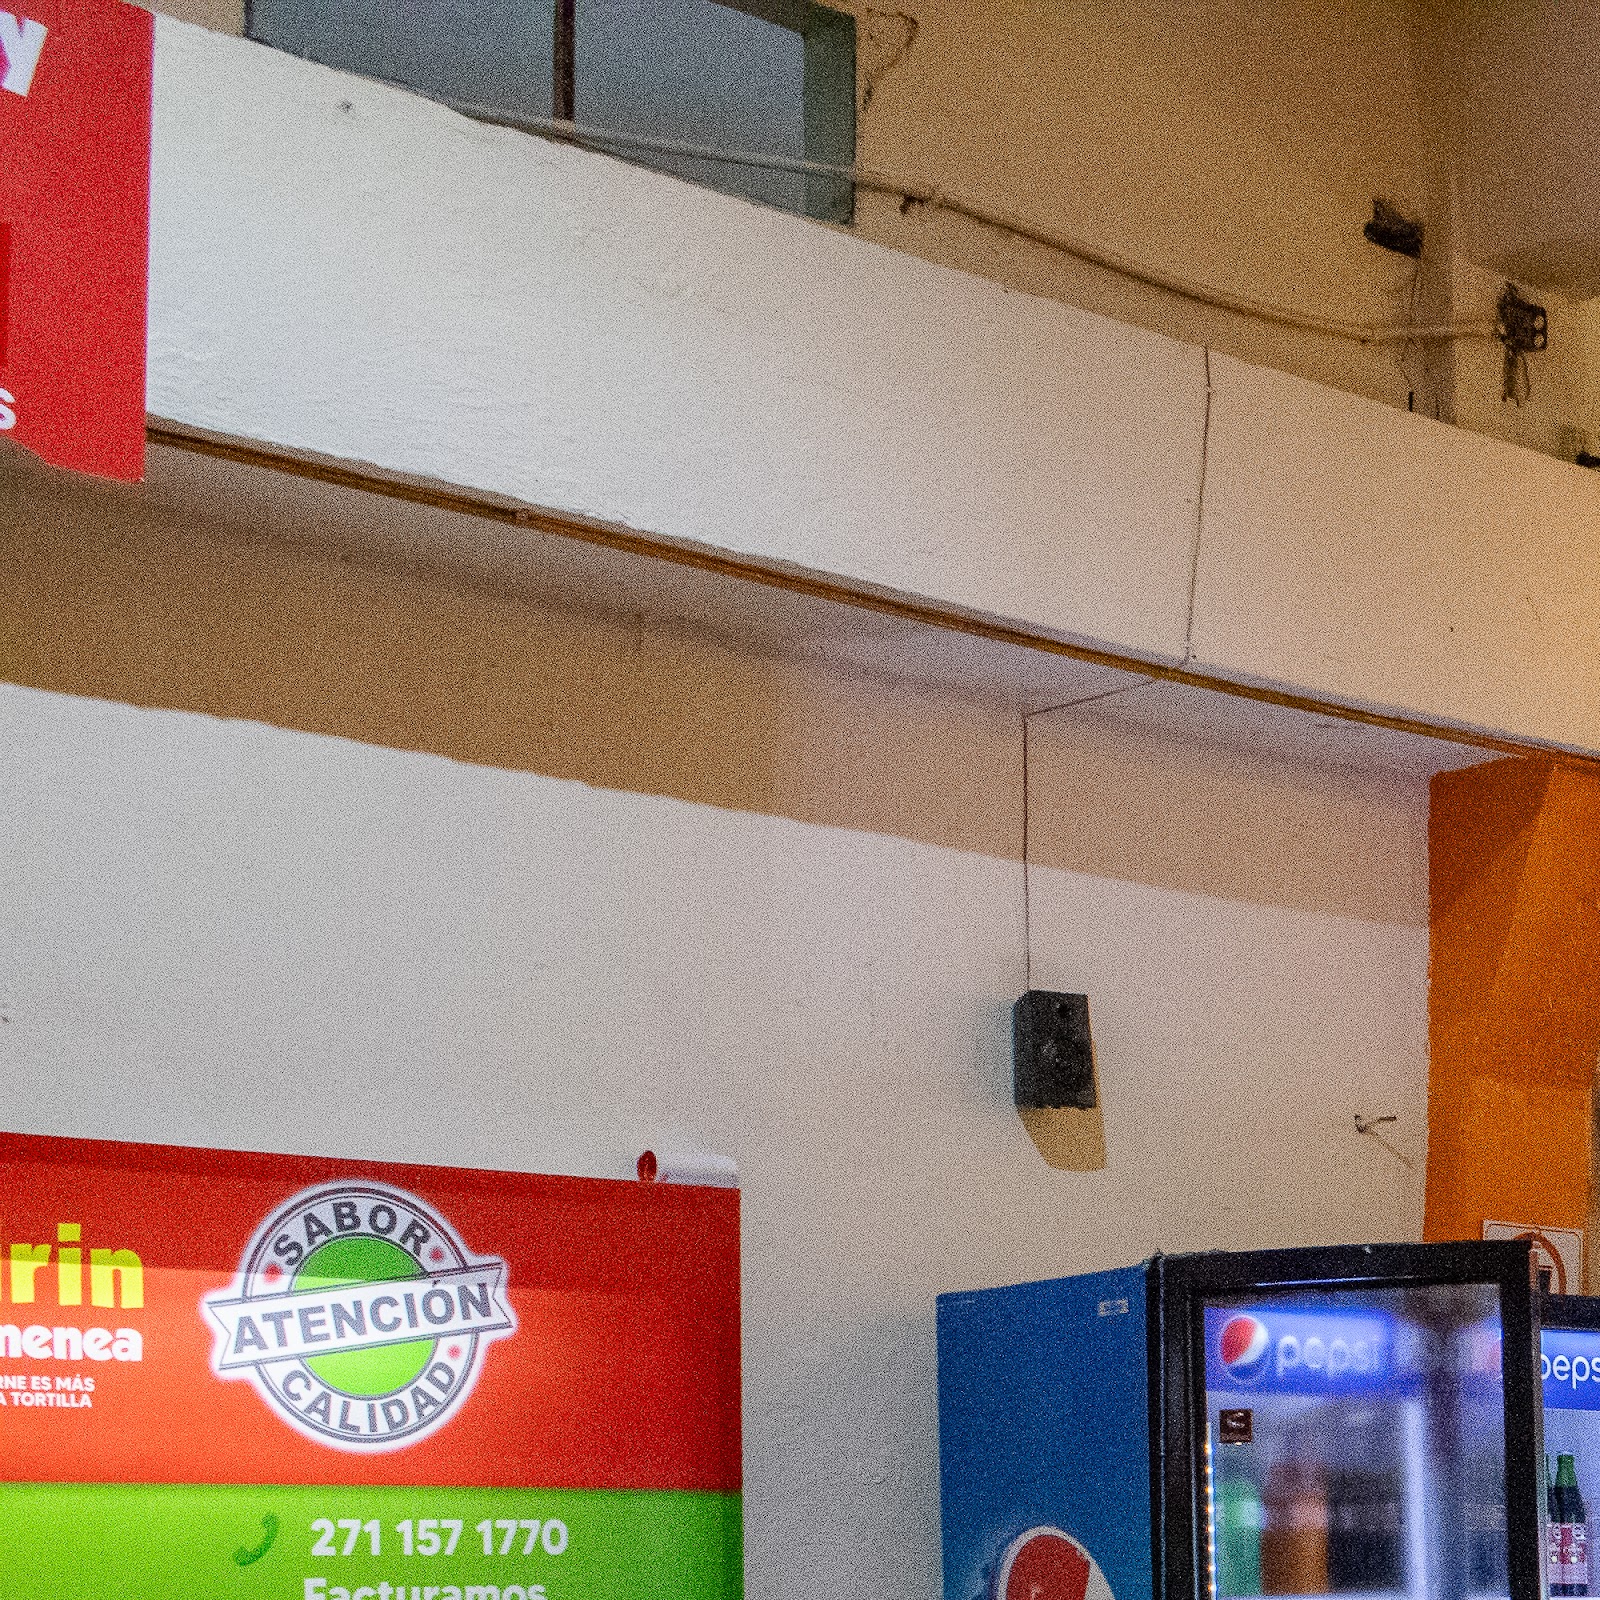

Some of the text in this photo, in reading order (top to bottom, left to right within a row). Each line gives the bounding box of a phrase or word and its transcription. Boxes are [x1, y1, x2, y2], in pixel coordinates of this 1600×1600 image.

[273, 1202, 431, 1266] SABOR
[233, 1278, 491, 1355] ATENCIÓN
[10, 1392, 93, 1408] TORTILLA
[31, 1376, 52, 1391] ES
[55, 1373, 96, 1392] MÁS
[282, 1358, 456, 1435] CALIDAD
[310, 1518, 568, 1557] 271 157 1770
